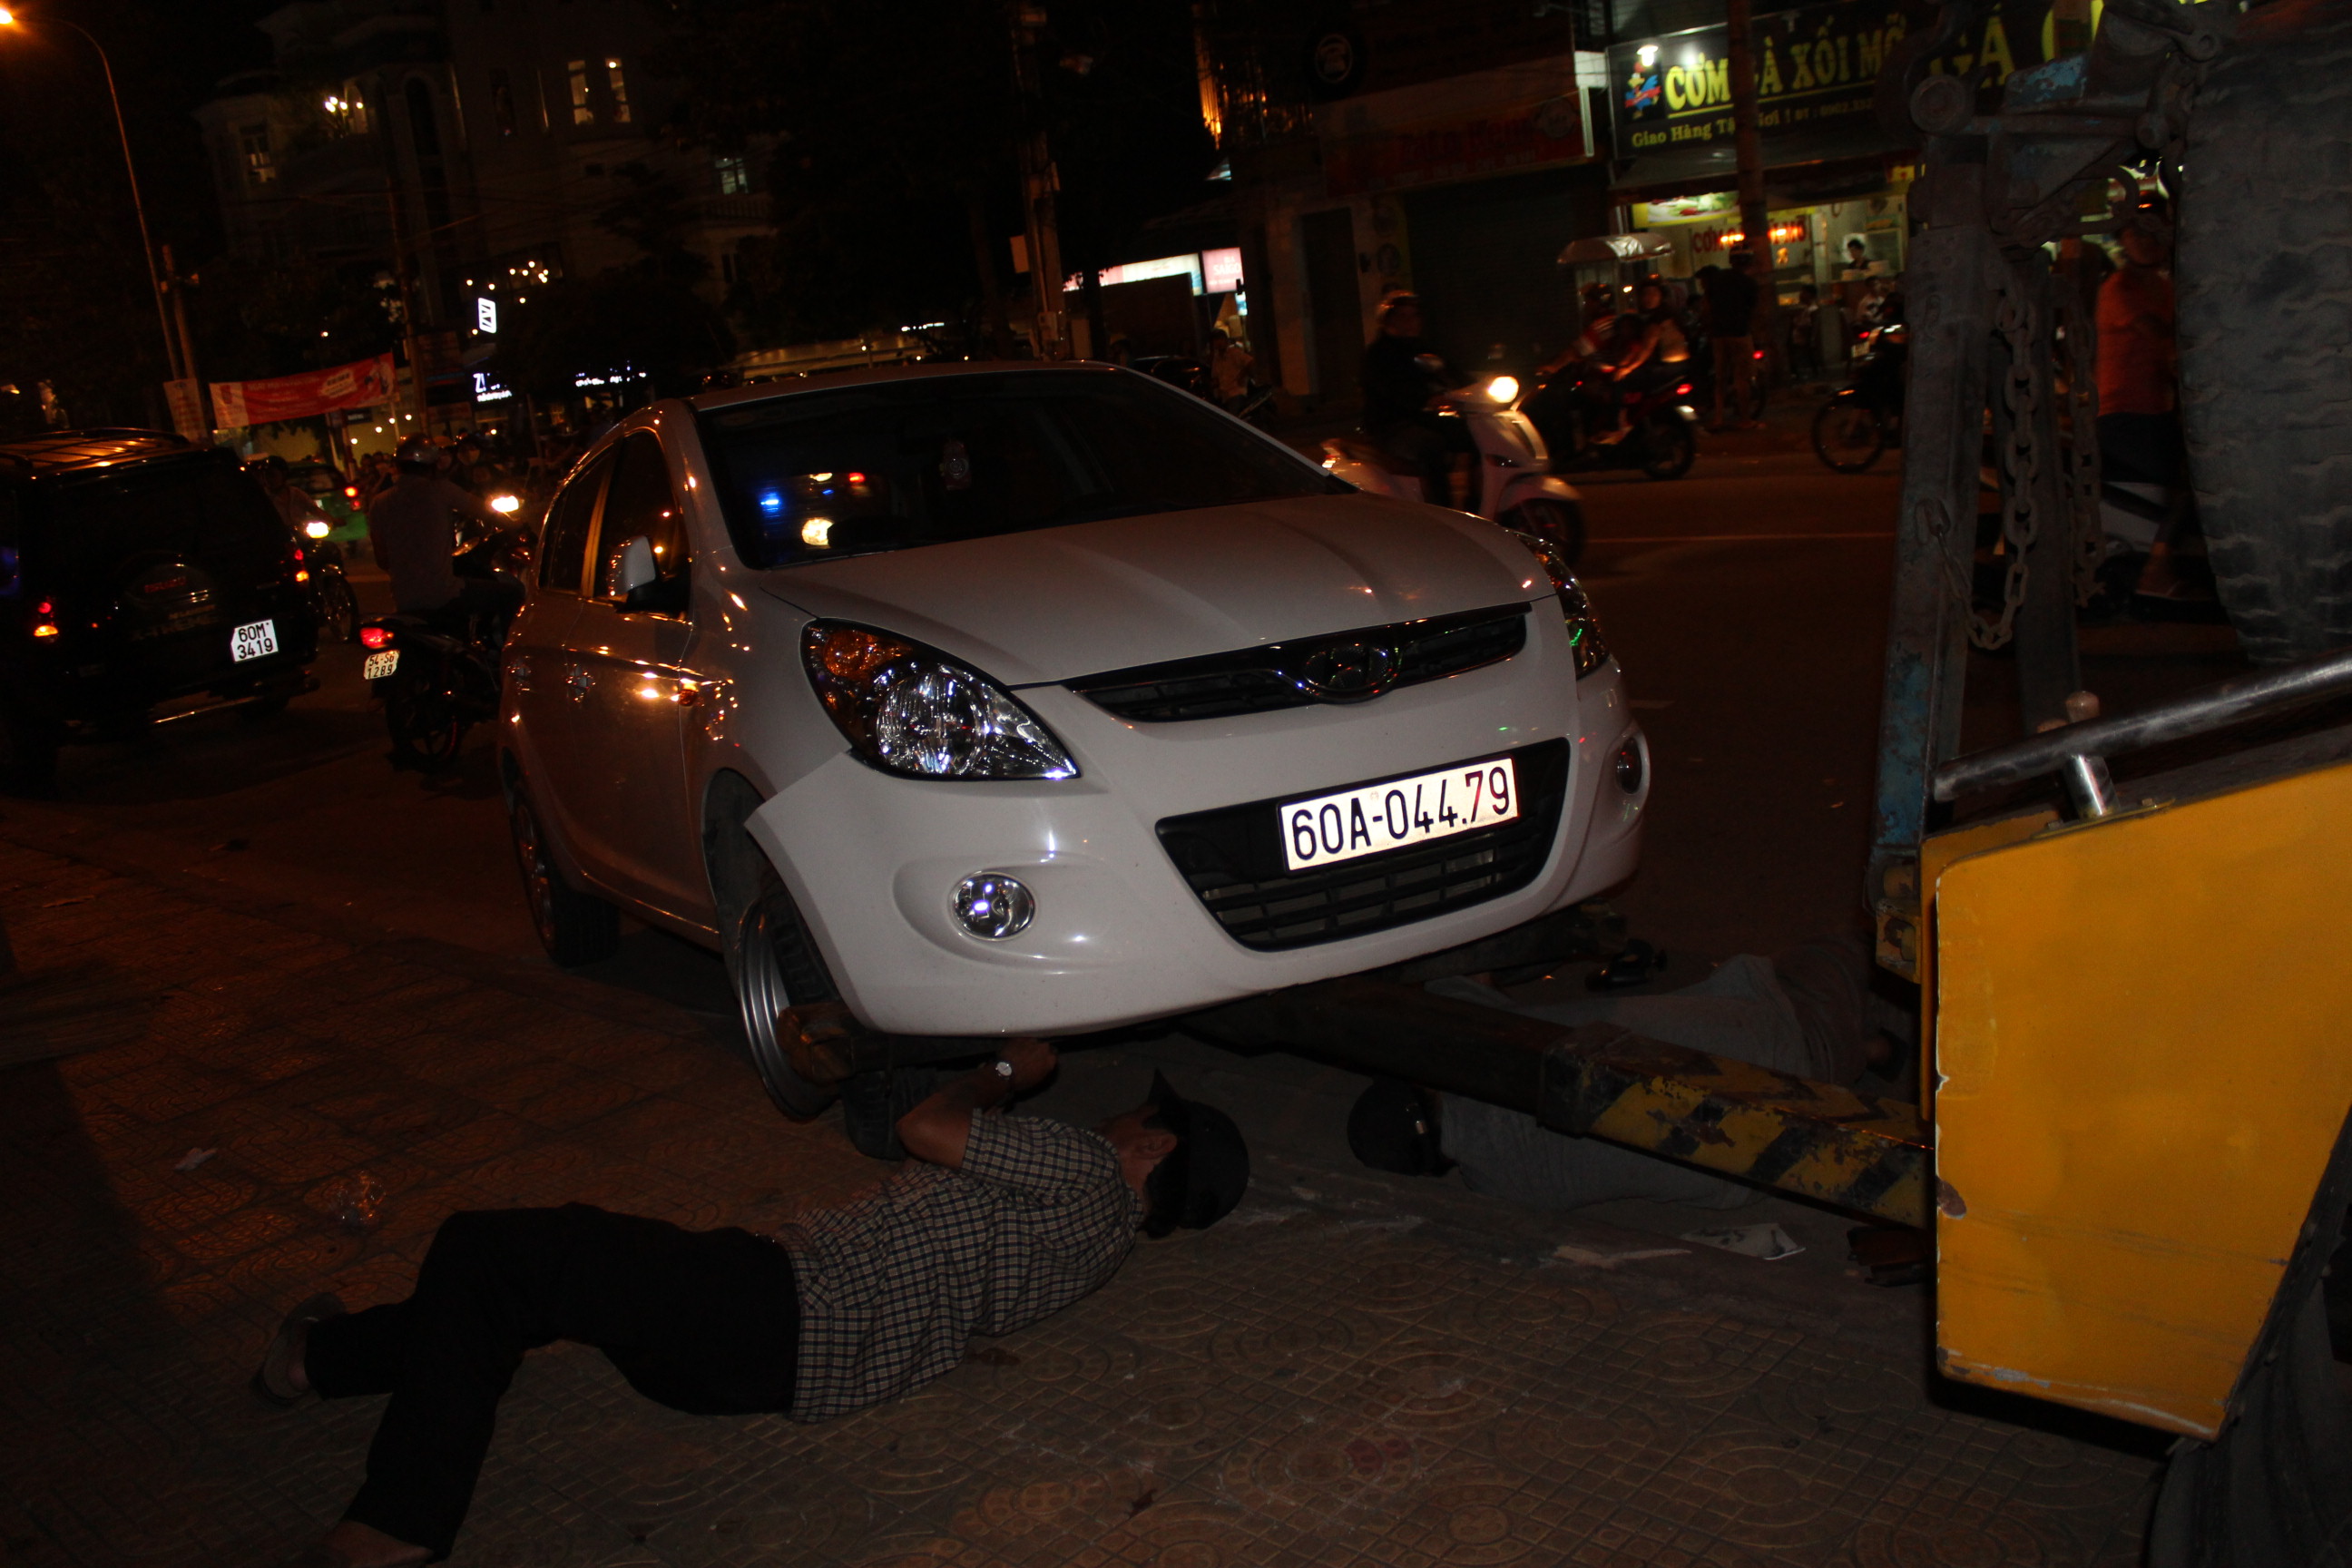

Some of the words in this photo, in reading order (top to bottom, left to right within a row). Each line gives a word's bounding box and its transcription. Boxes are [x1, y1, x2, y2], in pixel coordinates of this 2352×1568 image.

[1665, 52, 1731, 111] CƠM
[1753, 34, 1784, 95] À
[1789, 15, 1852, 89] XỐI
[1632, 130, 1668, 148] Giao
[1671, 121, 1713, 142] Hàng
[1213, 262, 1241, 275] SAIGO
[238, 623, 266, 642] 60M
[237, 638, 274, 659] 3419
[368, 663, 393, 679] 1289
[1290, 766, 1510, 861] 60A-044.79
